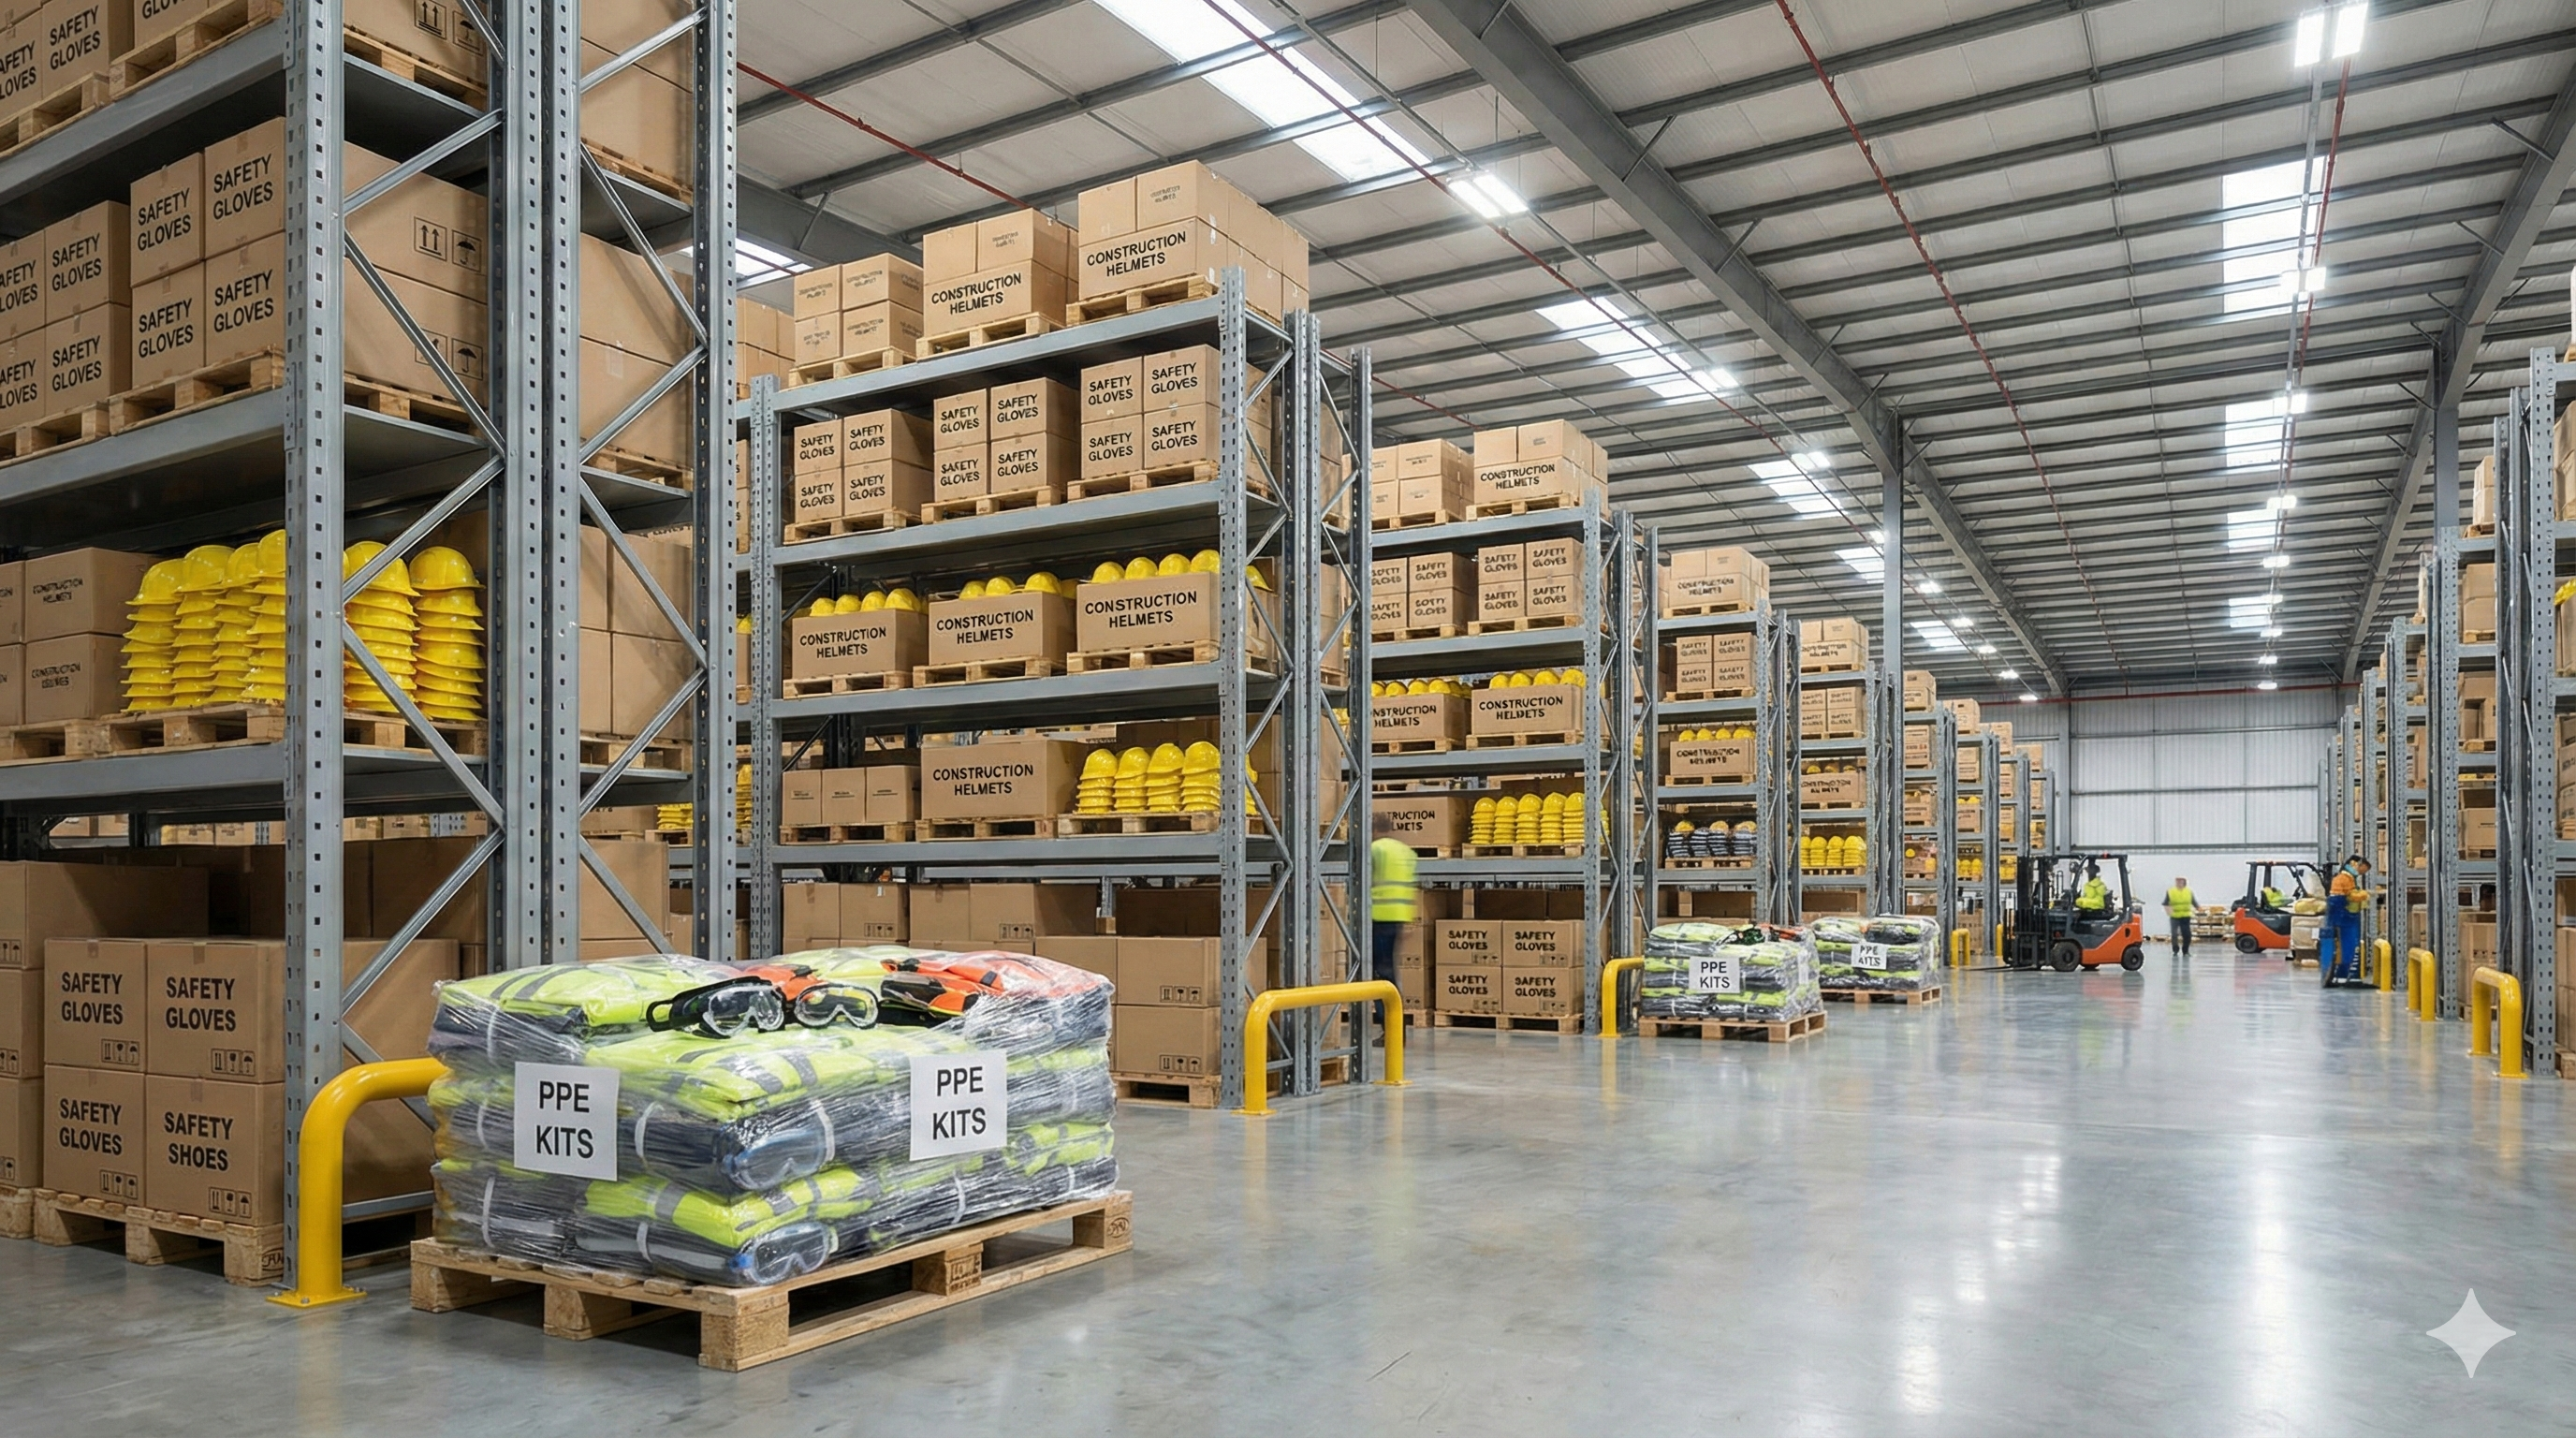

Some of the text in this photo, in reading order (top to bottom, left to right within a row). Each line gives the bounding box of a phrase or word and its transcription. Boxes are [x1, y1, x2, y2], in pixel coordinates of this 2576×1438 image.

[50, 5, 98, 46] SAFETY
[0, 40, 36, 74] AFETY
[50, 31, 100, 70] GLOVES
[0, 66, 37, 98] LOVES
[213, 154, 272, 193] SAFETY
[138, 188, 190, 227] SAFETY
[212, 182, 273, 220] GLOVES
[137, 215, 192, 252] GLOVES
[52, 234, 100, 267] SAFETY
[1087, 231, 1186, 267] CONSTRUCTION
[0, 259, 36, 290] AFETY
[51, 258, 102, 291] GLOVES
[1106, 251, 1165, 278] HELMETS
[0, 283, 37, 314] LOVES
[214, 270, 272, 307] SAFETY
[931, 271, 1021, 305] CONSTRUCTION
[949, 290, 1003, 315] HELMETS
[139, 299, 192, 334] SAFETY
[213, 298, 274, 333] GLOVES
[52, 335, 100, 368] SAFETY
[139, 326, 194, 359] GLOVES
[0, 360, 36, 385] AFETY
[51, 361, 102, 392] GLOVES
[1089, 374, 1132, 392] SAFETY
[1151, 362, 1197, 383] SAFETY
[1151, 376, 1198, 394] GLOVES
[0, 385, 37, 410] LOVES
[997, 393, 1038, 411] SAFETY
[940, 405, 979, 421] SAFETY
[997, 406, 1039, 423] GLOVES
[850, 424, 885, 439] SAFETY
[940, 418, 980, 434] GLOVES
[1151, 420, 1196, 438] SAFETY
[1089, 432, 1132, 448] SAFETY
[1151, 434, 1198, 452] GLOVES
[941, 458, 979, 475] SAFETY
[998, 448, 1037, 464] SAFETY
[1088, 446, 1134, 462] GLOVES
[940, 471, 980, 488] GLOVES
[997, 462, 1039, 477] GLOVES
[1480, 464, 1555, 481] CONSTRUCTION
[1084, 591, 1197, 616] CONSTRUCTION
[936, 609, 1033, 631] CONSTRUCTION
[1109, 609, 1174, 629] HELMETS
[799, 625, 886, 647] CONSTRUCTION
[957, 625, 1014, 646] HELMETS
[816, 641, 868, 660] HELMETS
[1371, 705, 1437, 717] NSTRUCTION
[1479, 696, 1563, 711] CONSTRUCTION
[933, 764, 1033, 782] CONSTRUCTION
[954, 780, 1012, 797] HELMETS
[1387, 810, 1435, 820] TRUCTION
[1448, 930, 1488, 939] SAFETY
[1515, 932, 1556, 941] SAFETY
[1448, 975, 1488, 984] SAFETY
[1701, 961, 1727, 974] PPE
[61, 971, 122, 995] SAFETY
[166, 976, 235, 1001] SAFETY
[1700, 976, 1730, 989] KITS
[61, 1001, 124, 1025] GLOVES
[166, 1006, 236, 1032] GLOVES
[936, 1066, 984, 1097] PPE
[538, 1080, 590, 1113] PPE
[60, 1098, 122, 1125] SAFETY
[932, 1108, 986, 1139] KITS
[164, 1111, 232, 1139] SAFETY
[59, 1127, 123, 1155] GLOVES
[535, 1125, 593, 1159] KITS
[168, 1143, 228, 1171] SHOES
